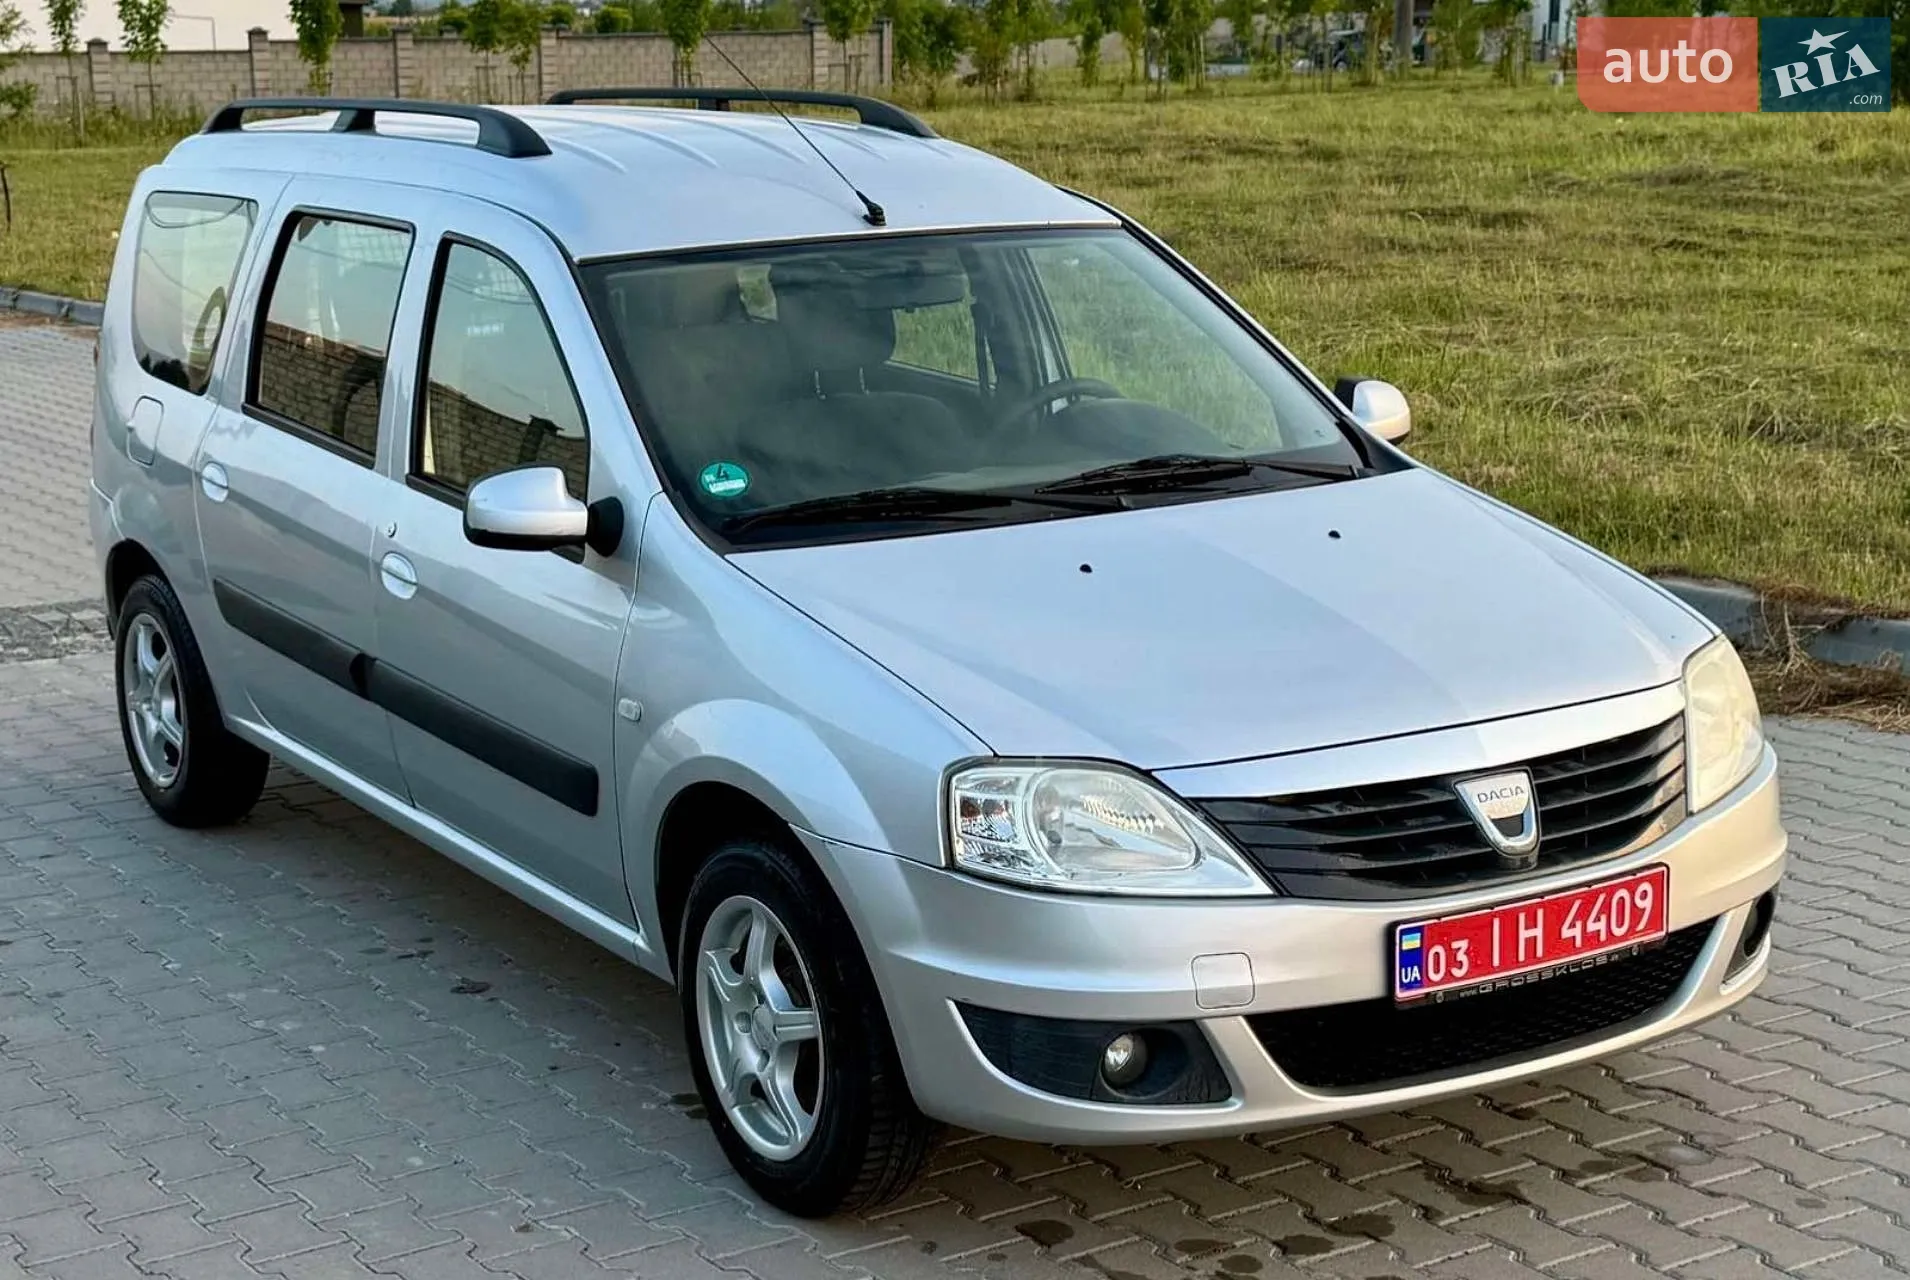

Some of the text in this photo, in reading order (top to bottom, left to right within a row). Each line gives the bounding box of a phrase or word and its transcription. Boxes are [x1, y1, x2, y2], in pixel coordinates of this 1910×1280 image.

[1477, 785, 1524, 803] DACIA
[1428, 938, 1469, 982] 03
[1561, 881, 1654, 948] 4409
[1401, 965, 1421, 983] UA
